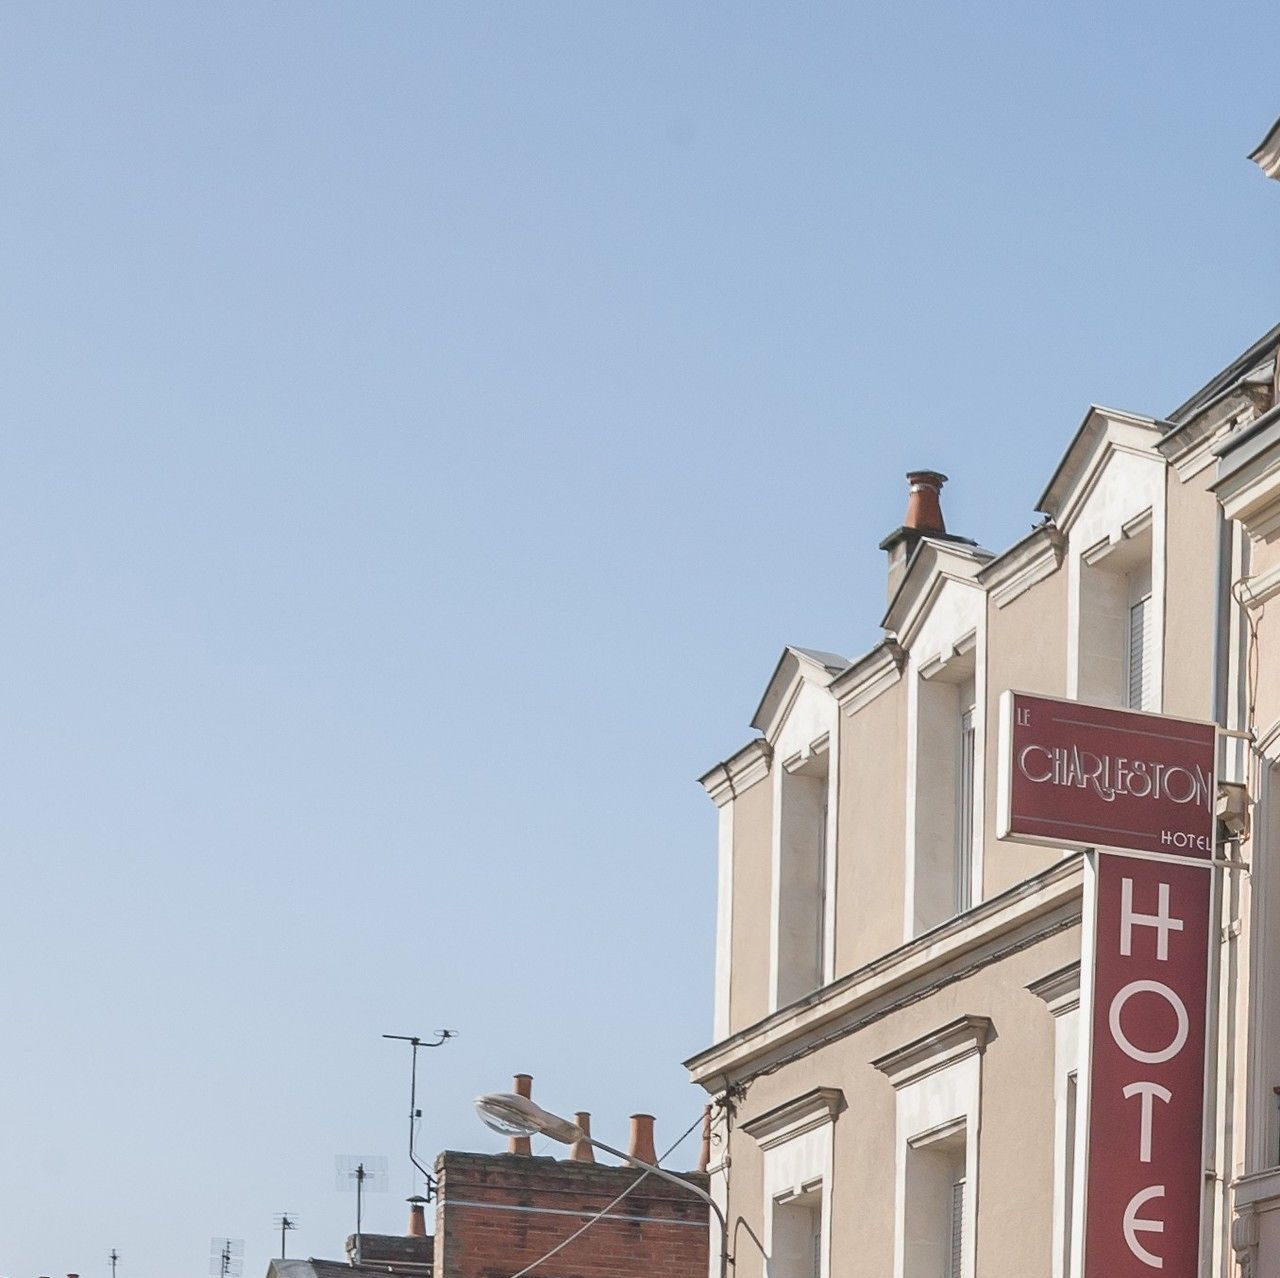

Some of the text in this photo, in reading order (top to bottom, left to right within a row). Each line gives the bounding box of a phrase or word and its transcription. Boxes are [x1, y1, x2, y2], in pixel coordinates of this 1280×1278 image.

[1017, 707, 1031, 727] LE
[1018, 743, 1212, 815] CHARLESTON
[1161, 830, 1212, 852] HOTEL
